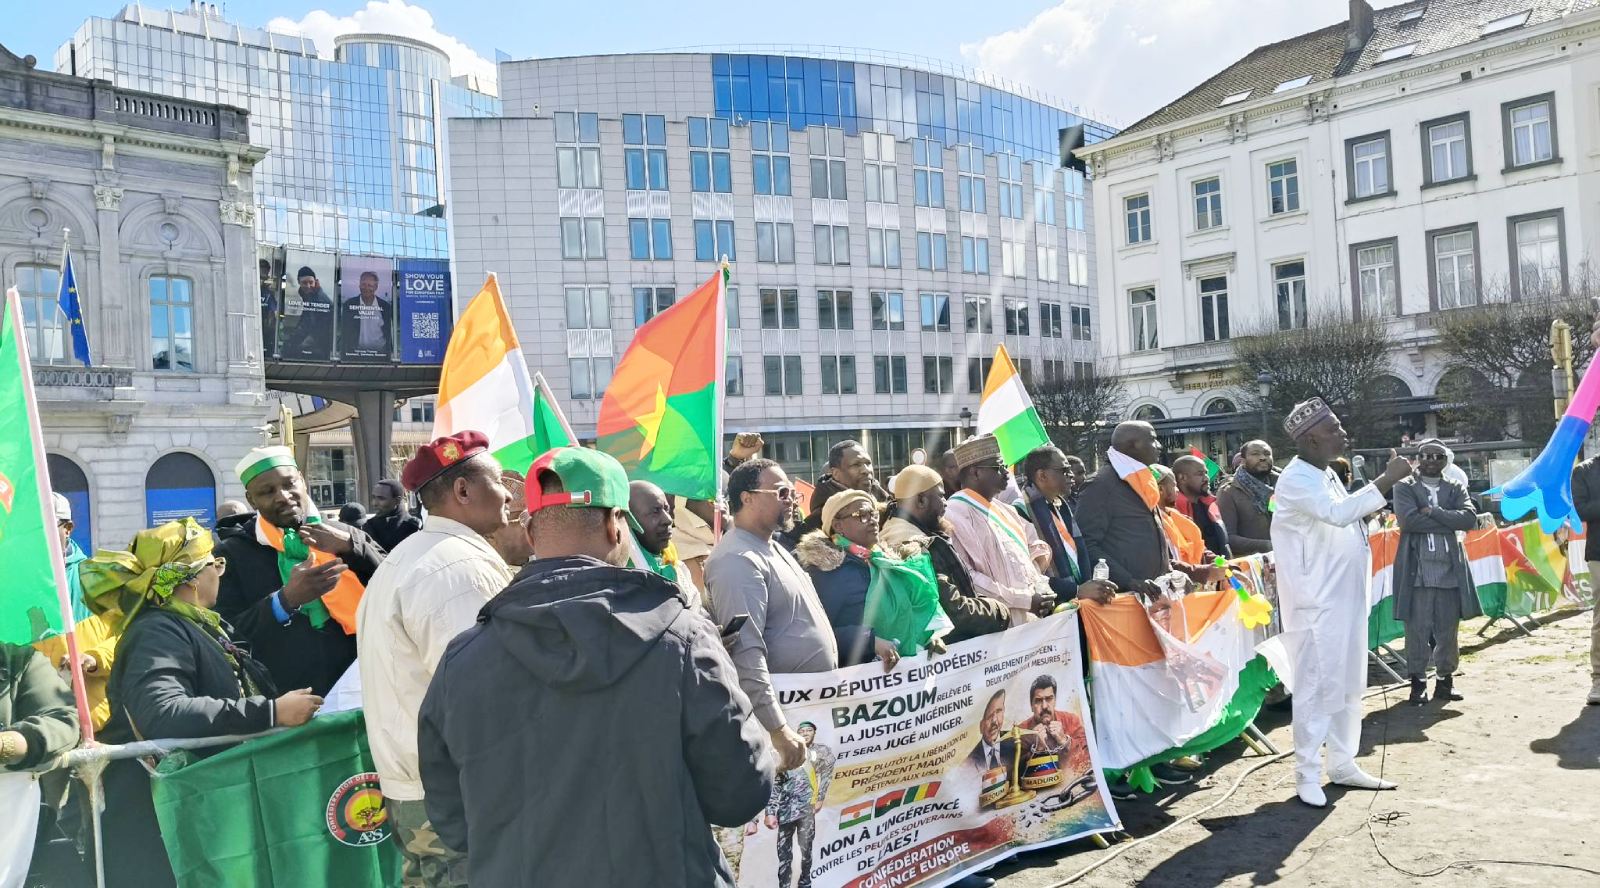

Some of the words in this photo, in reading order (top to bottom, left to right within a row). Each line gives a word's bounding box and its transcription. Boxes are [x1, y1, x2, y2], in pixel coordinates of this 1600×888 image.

[405, 280, 444, 291] LOVE
[984, 656, 1024, 676] PARLEMENT
[986, 675, 1002, 687] DEUX
[1031, 654, 1061, 668] MESURES
[779, 688, 814, 704] UX
[962, 682, 972, 692] DE
[832, 687, 937, 728] BAZOUM
[840, 734, 854, 744] LA
[858, 718, 912, 740] JUSTICE
[914, 696, 974, 726] NIGÉRIENNE
[834, 766, 872, 780] EXIGEZ
[874, 755, 908, 772] PLUTÔT
[922, 738, 958, 758] LIBÉRATION
[837, 750, 851, 760] ET
[852, 744, 882, 757] SERA
[884, 731, 916, 750] JUGÉ
[918, 730, 930, 740] AU
[852, 764, 912, 788] PRÉSIDENT
[916, 748, 956, 770] MADURO
[900, 772, 920, 784] AUX
[1026, 776, 1060, 785] MADURO
[820, 834, 855, 860] NON
[858, 826, 870, 842] À
[876, 798, 960, 836] L'INGÉRENCE
[810, 856, 845, 880] CONTRE
[846, 848, 862, 860] LES
[901, 811, 963, 834] SOUVERAINS
[920, 842, 970, 873] EUROPE
[857, 856, 874, 872] DE
[859, 835, 955, 888] CONFÉDÉRATION
